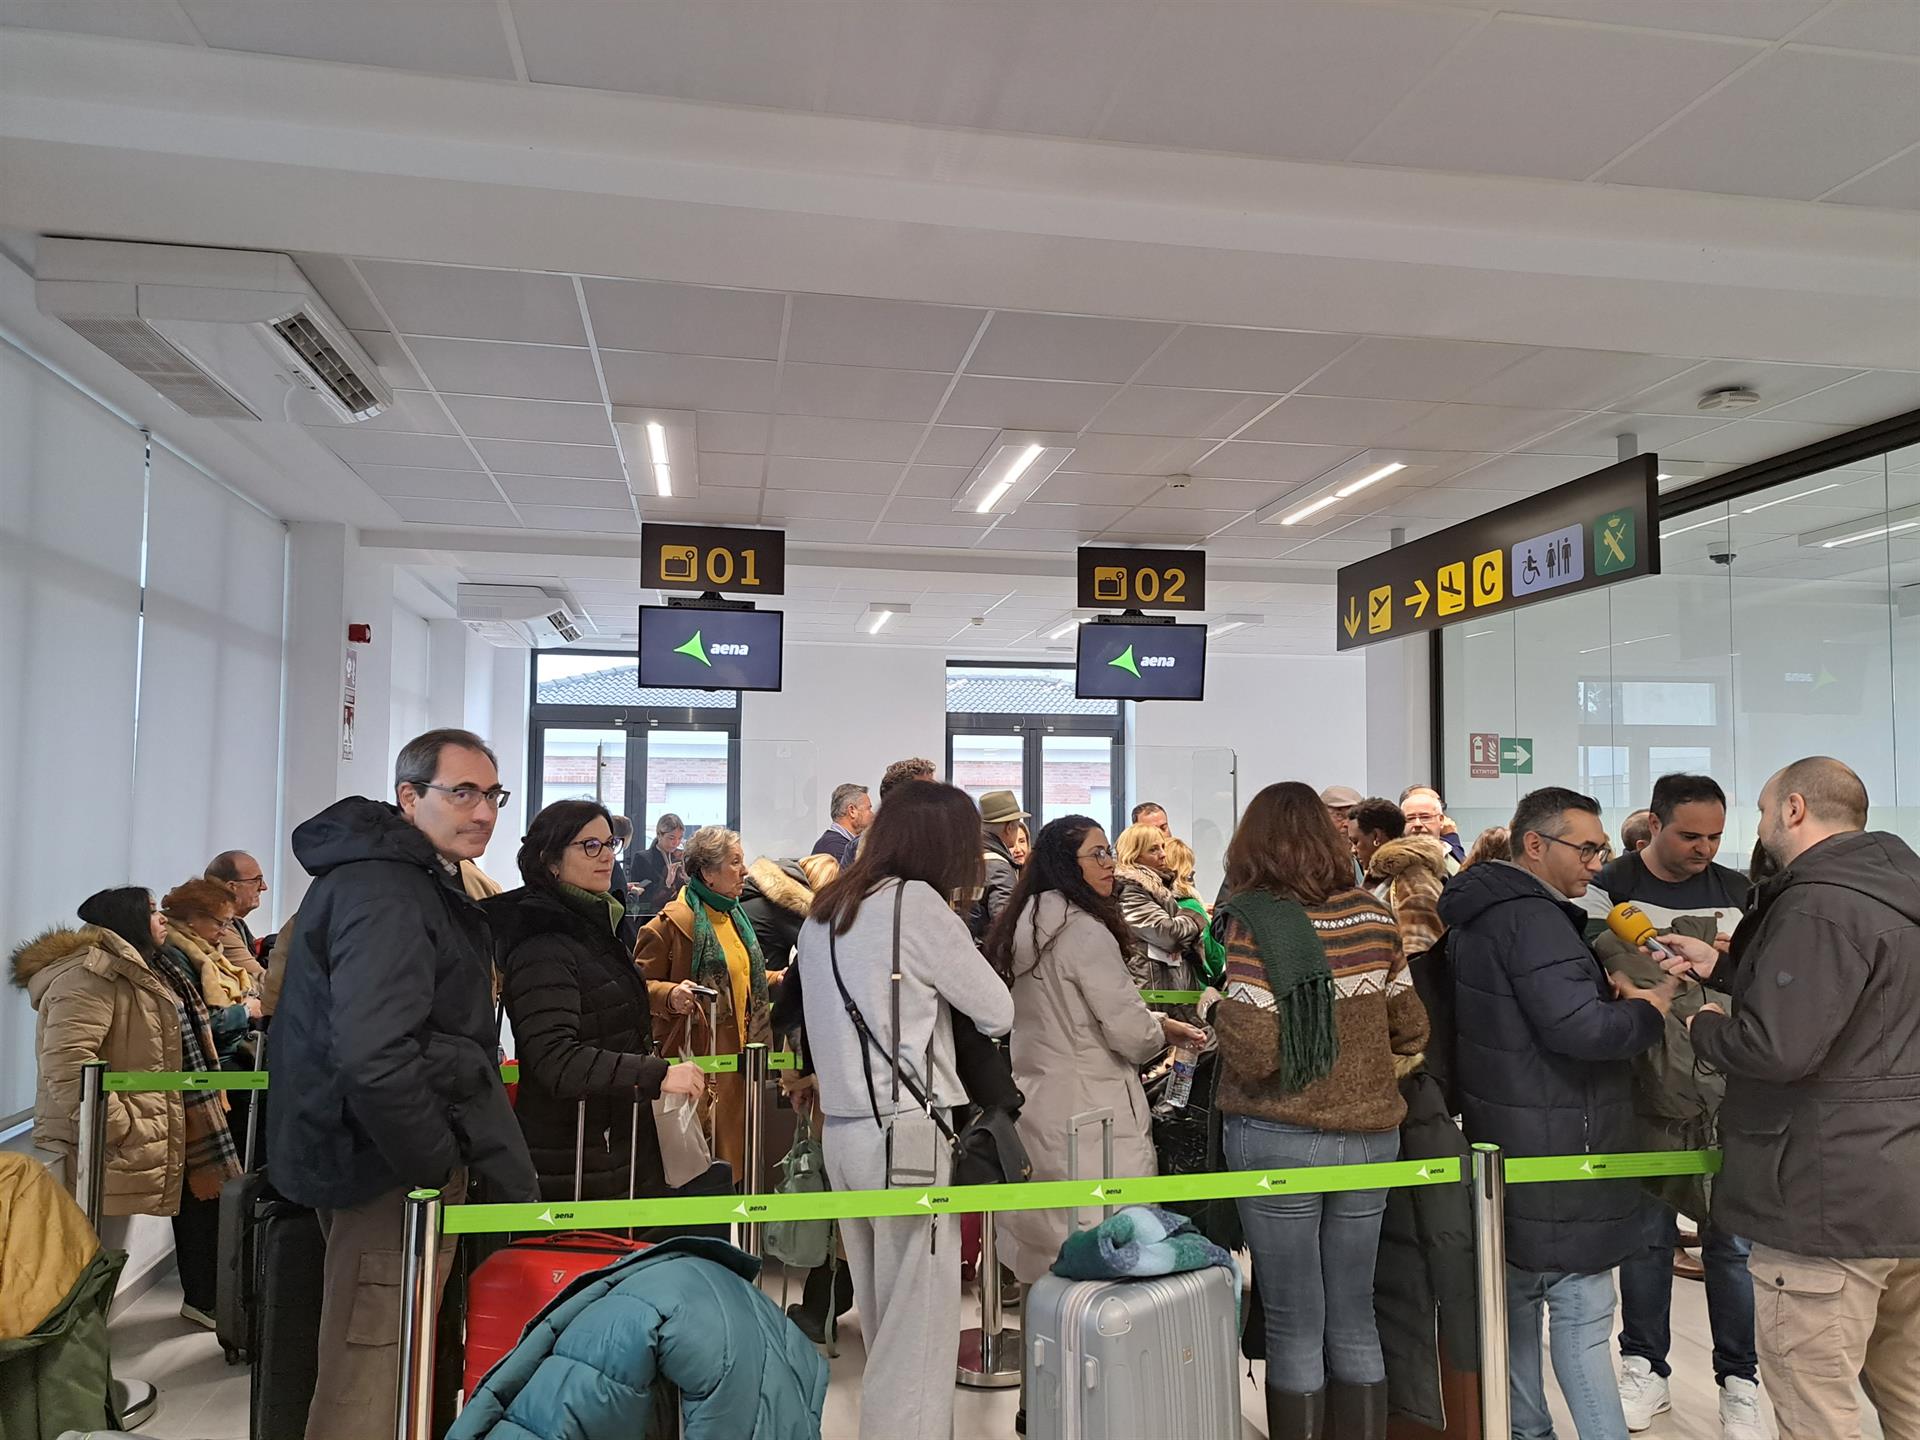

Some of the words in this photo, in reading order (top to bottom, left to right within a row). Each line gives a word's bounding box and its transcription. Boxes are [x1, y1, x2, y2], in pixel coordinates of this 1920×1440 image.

[706, 546, 760, 586] 01
[1480, 560, 1496, 596] C
[1134, 567, 1186, 603] 02
[710, 642, 750, 656] aena
[1140, 655, 1176, 667] aena
[1429, 1167, 1445, 1175] aena
[932, 1196, 949, 1204] aena
[749, 1204, 767, 1212] aena
